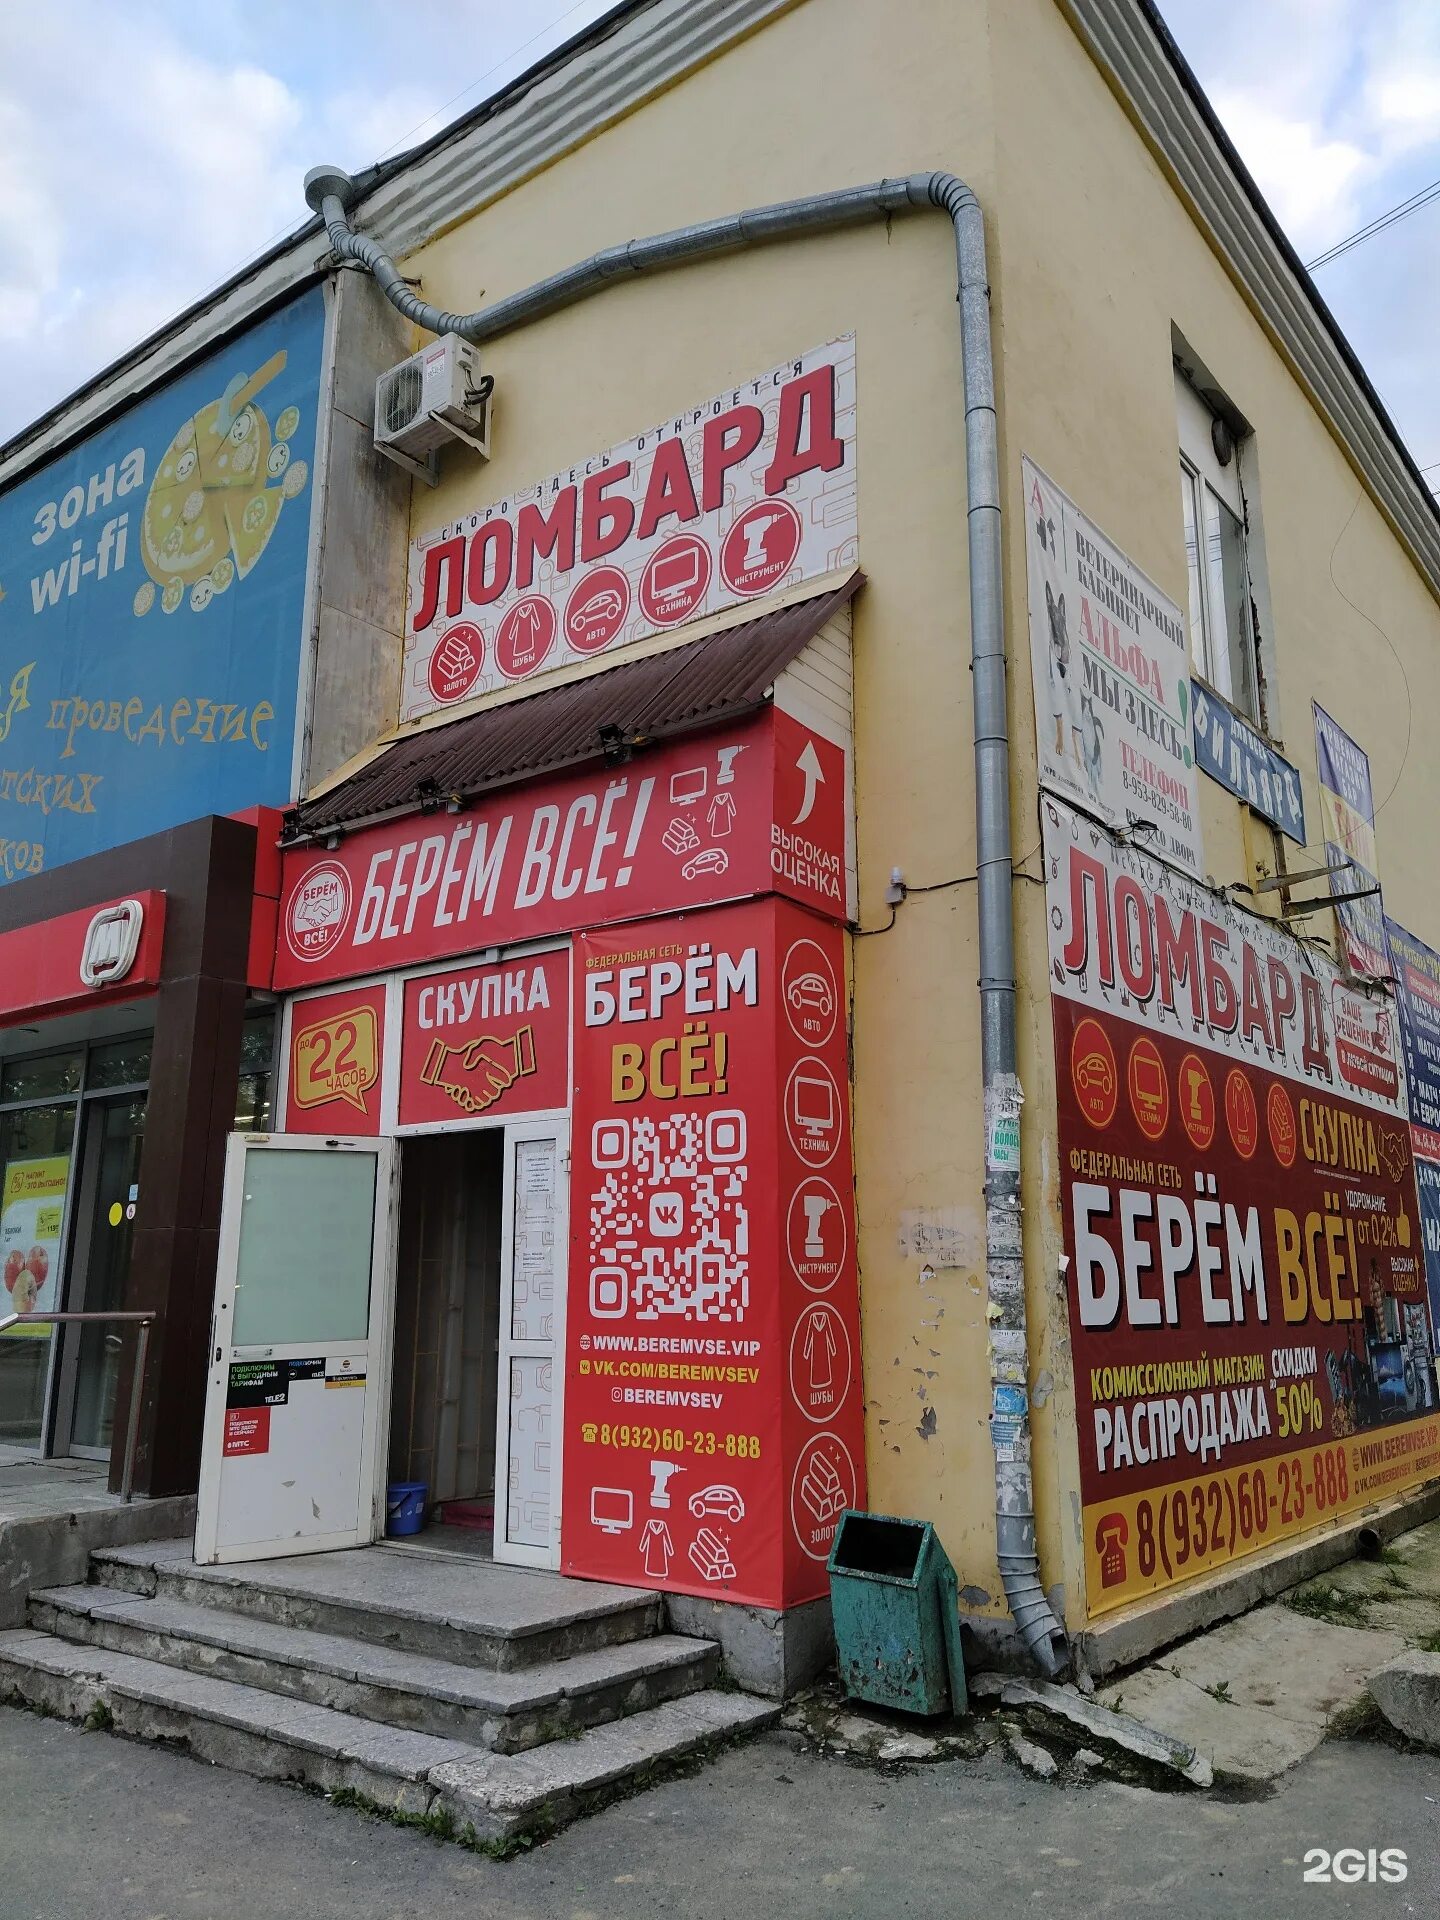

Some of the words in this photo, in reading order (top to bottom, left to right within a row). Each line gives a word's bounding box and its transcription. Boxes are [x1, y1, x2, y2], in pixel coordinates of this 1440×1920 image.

[442, 502, 508, 541] СКОРО
[537, 455, 610, 498] ЗДЕСЬ
[637, 361, 803, 450] ОТКРОЕТСЯ
[31, 447, 147, 546] зона
[413, 364, 844, 631] ЛОМБАРД
[30, 513, 129, 614] wi-fi
[734, 560, 786, 586] ИНСТРУМЕНТ
[655, 596, 693, 616] ТЕХНИКА
[1075, 529, 1185, 651] ВЕТЕРИНАРНЫЙ
[1077, 558, 1141, 636] КАБИНЕТ
[586, 627, 606, 642] АВТО
[1078, 595, 1166, 706] АЛЬФА
[512, 653, 535, 668] ШУБЫ
[443, 677, 468, 693] ЗОЛОТО
[1082, 653, 1121, 716] МЫ
[46, 696, 276, 759] проведение
[1119, 738, 1189, 811] ТЕЛЕФОН
[352, 816, 514, 947] БЕРЁМ
[514, 776, 656, 911] ВСЁ!
[770, 823, 840, 875] ВЫСОКАЯ
[303, 880, 338, 901] БЕРЁМ
[770, 848, 842, 901] ОЦЕНКА
[303, 927, 328, 946] ВСЁ!
[585, 948, 656, 969] ФЕДЕРАЛЬНАЯ
[659, 944, 683, 957] СЕТЬ
[585, 942, 758, 1027] БЕРЁМ
[1064, 845, 1332, 1086] ЛОМБАРД
[418, 966, 550, 1029] СКУПКА
[1342, 999, 1363, 1023] ВАШЕ
[803, 1017, 821, 1033] АВТО
[1337, 1015, 1372, 1047] РЕШЕНИЕ
[309, 1021, 357, 1083] 22
[611, 1020, 727, 1102] ВСЁ!
[326, 1067, 367, 1092] ЧАСОВ
[1089, 1097, 1104, 1112] АВТО
[799, 1137, 830, 1152] ТЕХНИКА
[1300, 1098, 1381, 1177] СКУПКА
[1069, 1147, 1154, 1186] ФЕДЕРАЛЬНАЯ
[1157, 1163, 1183, 1190] СЕТЬ
[1345, 1188, 1387, 1213] УДОРОЖАНИЕ
[798, 1261, 838, 1275] ИНСТРУМЕНТ
[1072, 1171, 1268, 1327] БЕРЁМ
[1274, 1191, 1363, 1323] ВСЁ!
[593, 1335, 761, 1357] WWW.BEREMVSE.VIP
[1271, 1346, 1318, 1379] СКИДКИ
[593, 1360, 760, 1384] VK.COM/BEREMVSEV
[1090, 1351, 1211, 1402] КОМИССИОННЫЙ
[1213, 1354, 1266, 1386] МАГАЗИН
[264, 1392, 286, 1403] TELE2
[624, 1388, 723, 1409] BEREMVSEV
[810, 1390, 834, 1405] ШУБЫ
[1276, 1379, 1323, 1438] 50%
[601, 1423, 761, 1459] 8(932)60-23-888
[1093, 1386, 1272, 1473] РАСПРОДАЖА
[1136, 1445, 1349, 1580] 8(932)60-23-888
